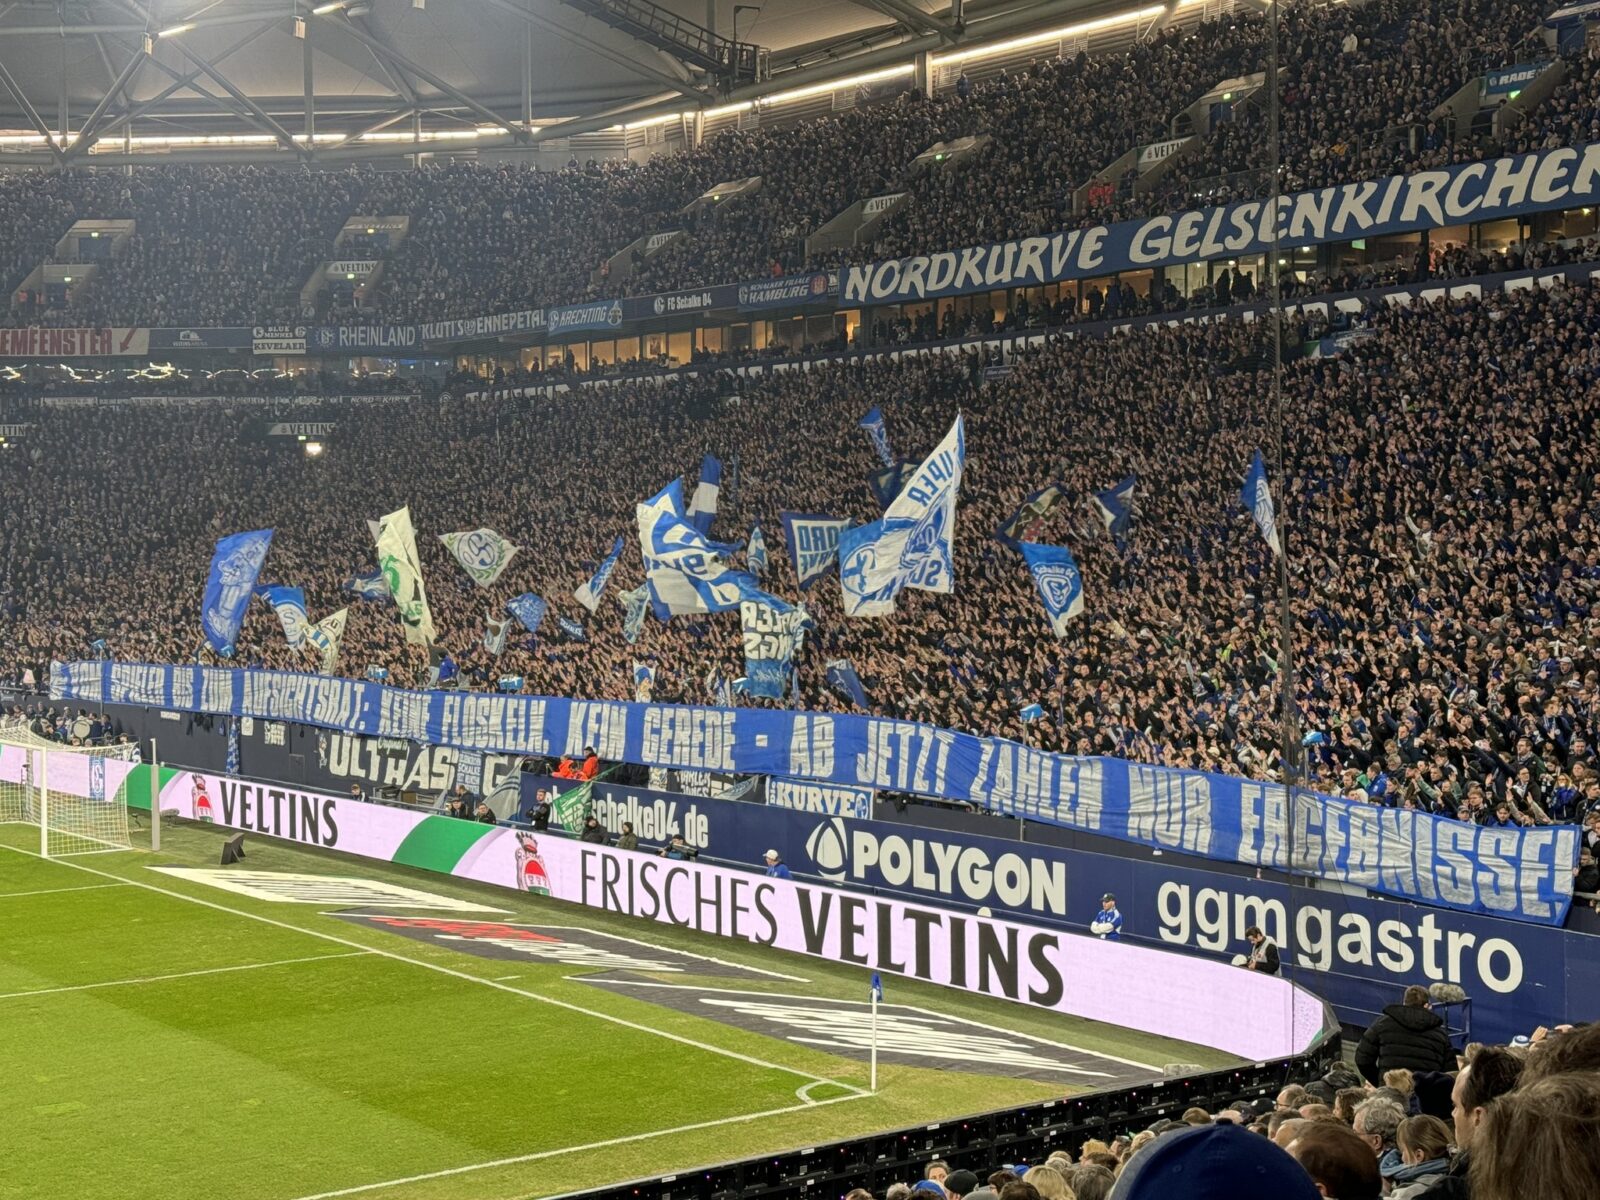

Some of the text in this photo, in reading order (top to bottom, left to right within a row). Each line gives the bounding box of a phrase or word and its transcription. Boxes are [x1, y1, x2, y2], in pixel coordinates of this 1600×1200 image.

[845, 226, 1108, 302] NORDKURVE
[668, 296, 676, 311] FC
[677, 294, 702, 309] Schalke
[749, 284, 809, 303] HAMBURG
[340, 326, 416, 346] RHEINLAND
[477, 309, 547, 334] ENNEPETAL
[254, 342, 305, 350] KEVELAER
[289, 423, 335, 434] VELTINS
[329, 734, 460, 791] ULTRAS
[200, 668, 232, 712] ZUM
[242, 671, 370, 730] AUFSICHTSRAT:
[377, 689, 432, 742] KEINE
[565, 701, 628, 761] KEIN
[641, 707, 736, 771] GEREDE
[789, 714, 835, 778] AB
[856, 720, 955, 795] JETZT
[1127, 764, 1212, 854] NUR
[1238, 783, 1576, 918] ERGEBNISSE!
[776, 781, 855, 817] KURVE
[219, 780, 339, 848] VELTINS
[853, 830, 1067, 915] POLYGON
[580, 848, 1064, 1006] FRISCHES VELTINS
